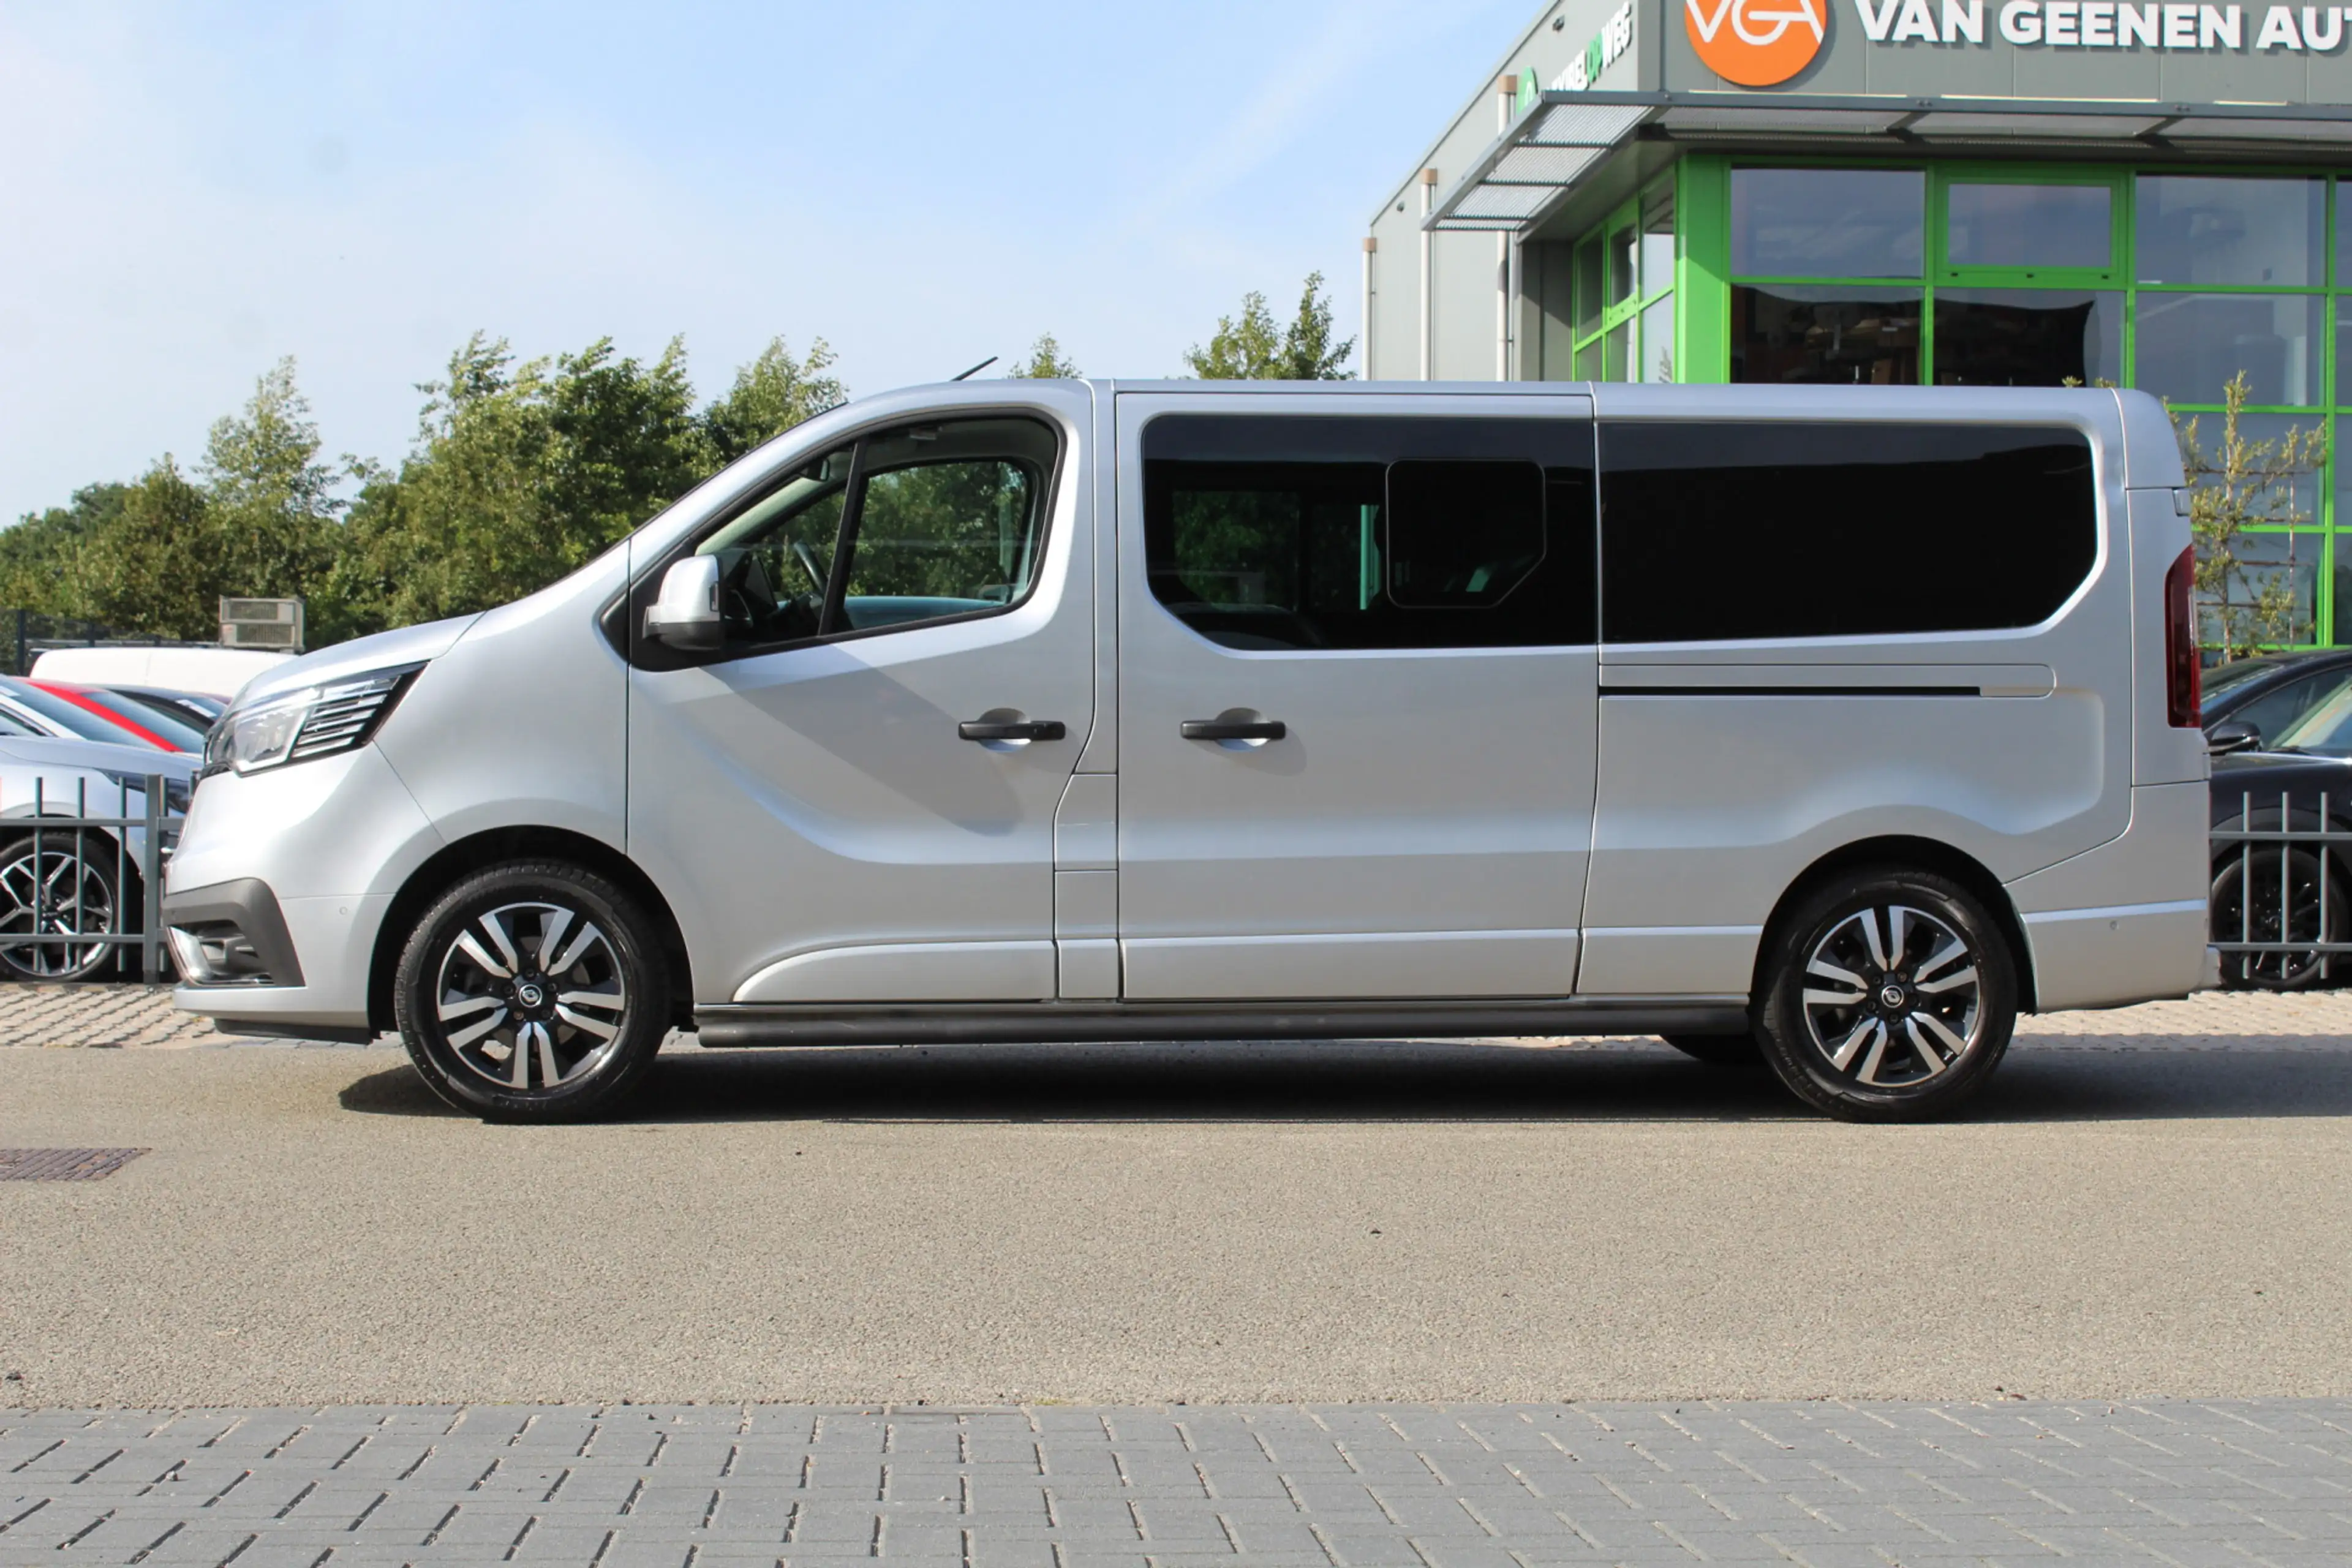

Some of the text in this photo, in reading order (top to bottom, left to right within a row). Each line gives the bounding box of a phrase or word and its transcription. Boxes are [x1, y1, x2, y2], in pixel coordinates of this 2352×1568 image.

[1687, 0, 1823, 45] VGA
[1855, 0, 2352, 51] VAN GEENEN AU
